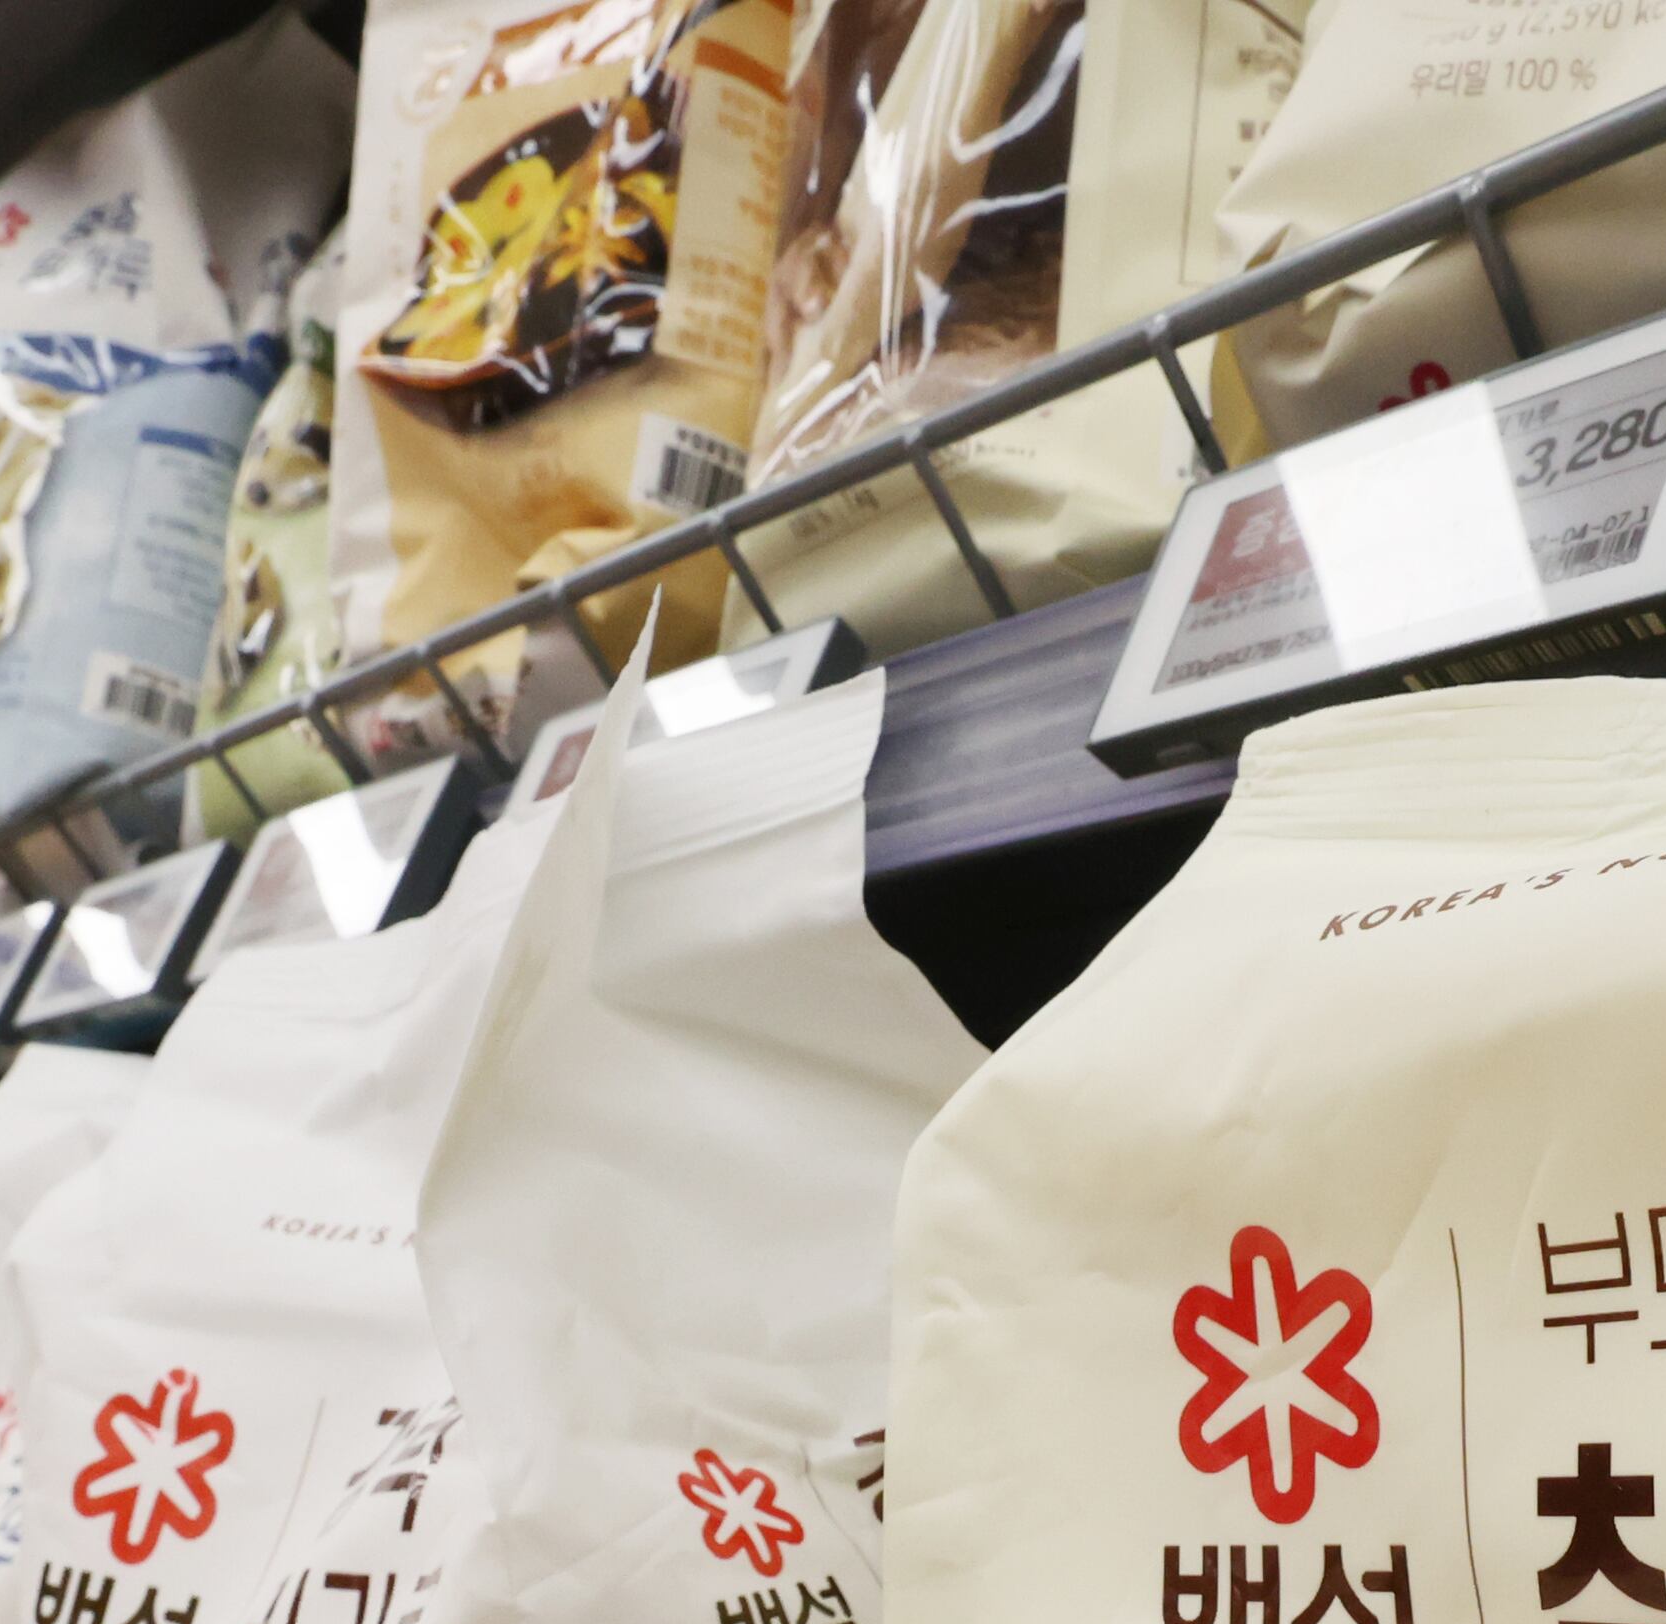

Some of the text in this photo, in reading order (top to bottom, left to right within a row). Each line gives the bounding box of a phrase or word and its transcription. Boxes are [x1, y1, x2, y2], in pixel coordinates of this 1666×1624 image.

[1408, 58, 1491, 98] 우리밀
[1504, 57, 1558, 93] 100
[1319, 867, 1575, 942] KOREA'S
